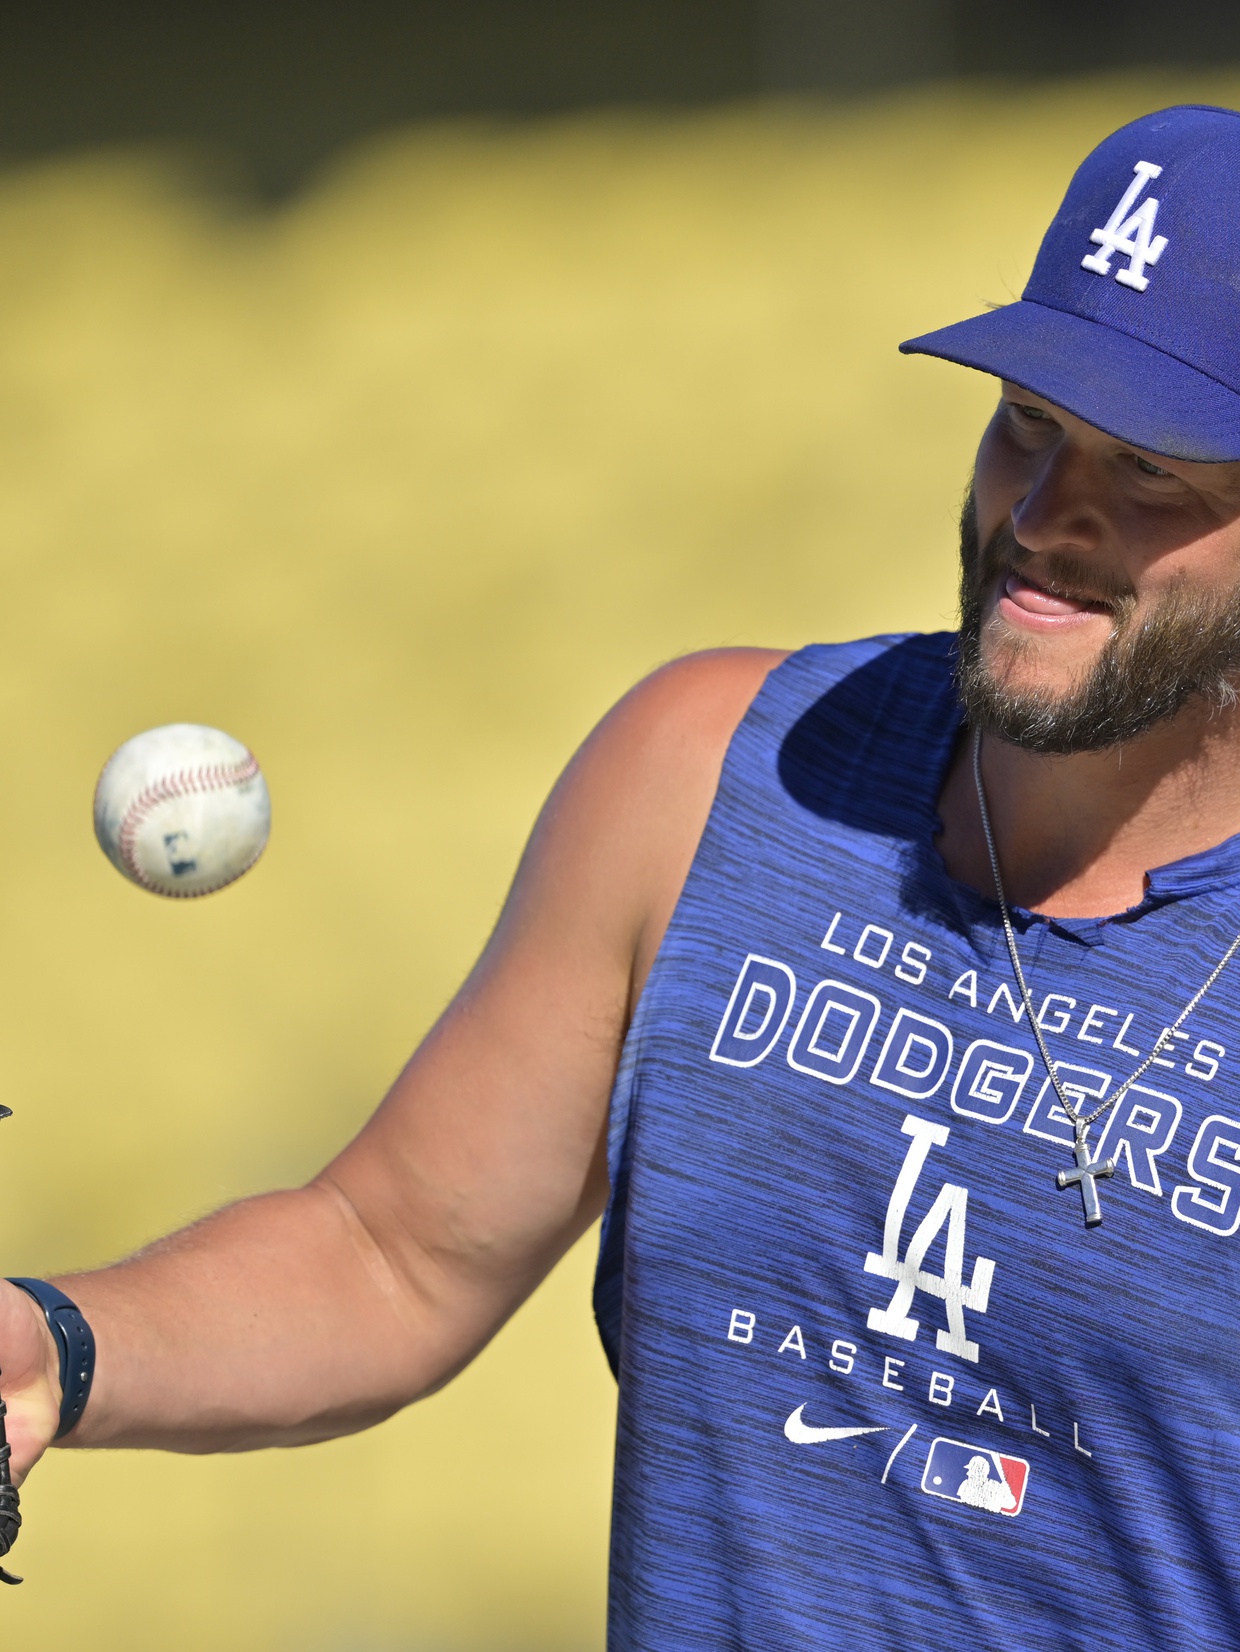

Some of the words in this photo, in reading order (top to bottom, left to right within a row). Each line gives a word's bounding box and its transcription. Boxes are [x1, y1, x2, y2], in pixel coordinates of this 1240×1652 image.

[1080, 160, 1169, 292] LA
[820, 911, 932, 985] LOS
[949, 969, 1226, 1081] ANGELES
[863, 1114, 996, 1363] LA
[727, 1308, 1093, 1458] BASEBALL
